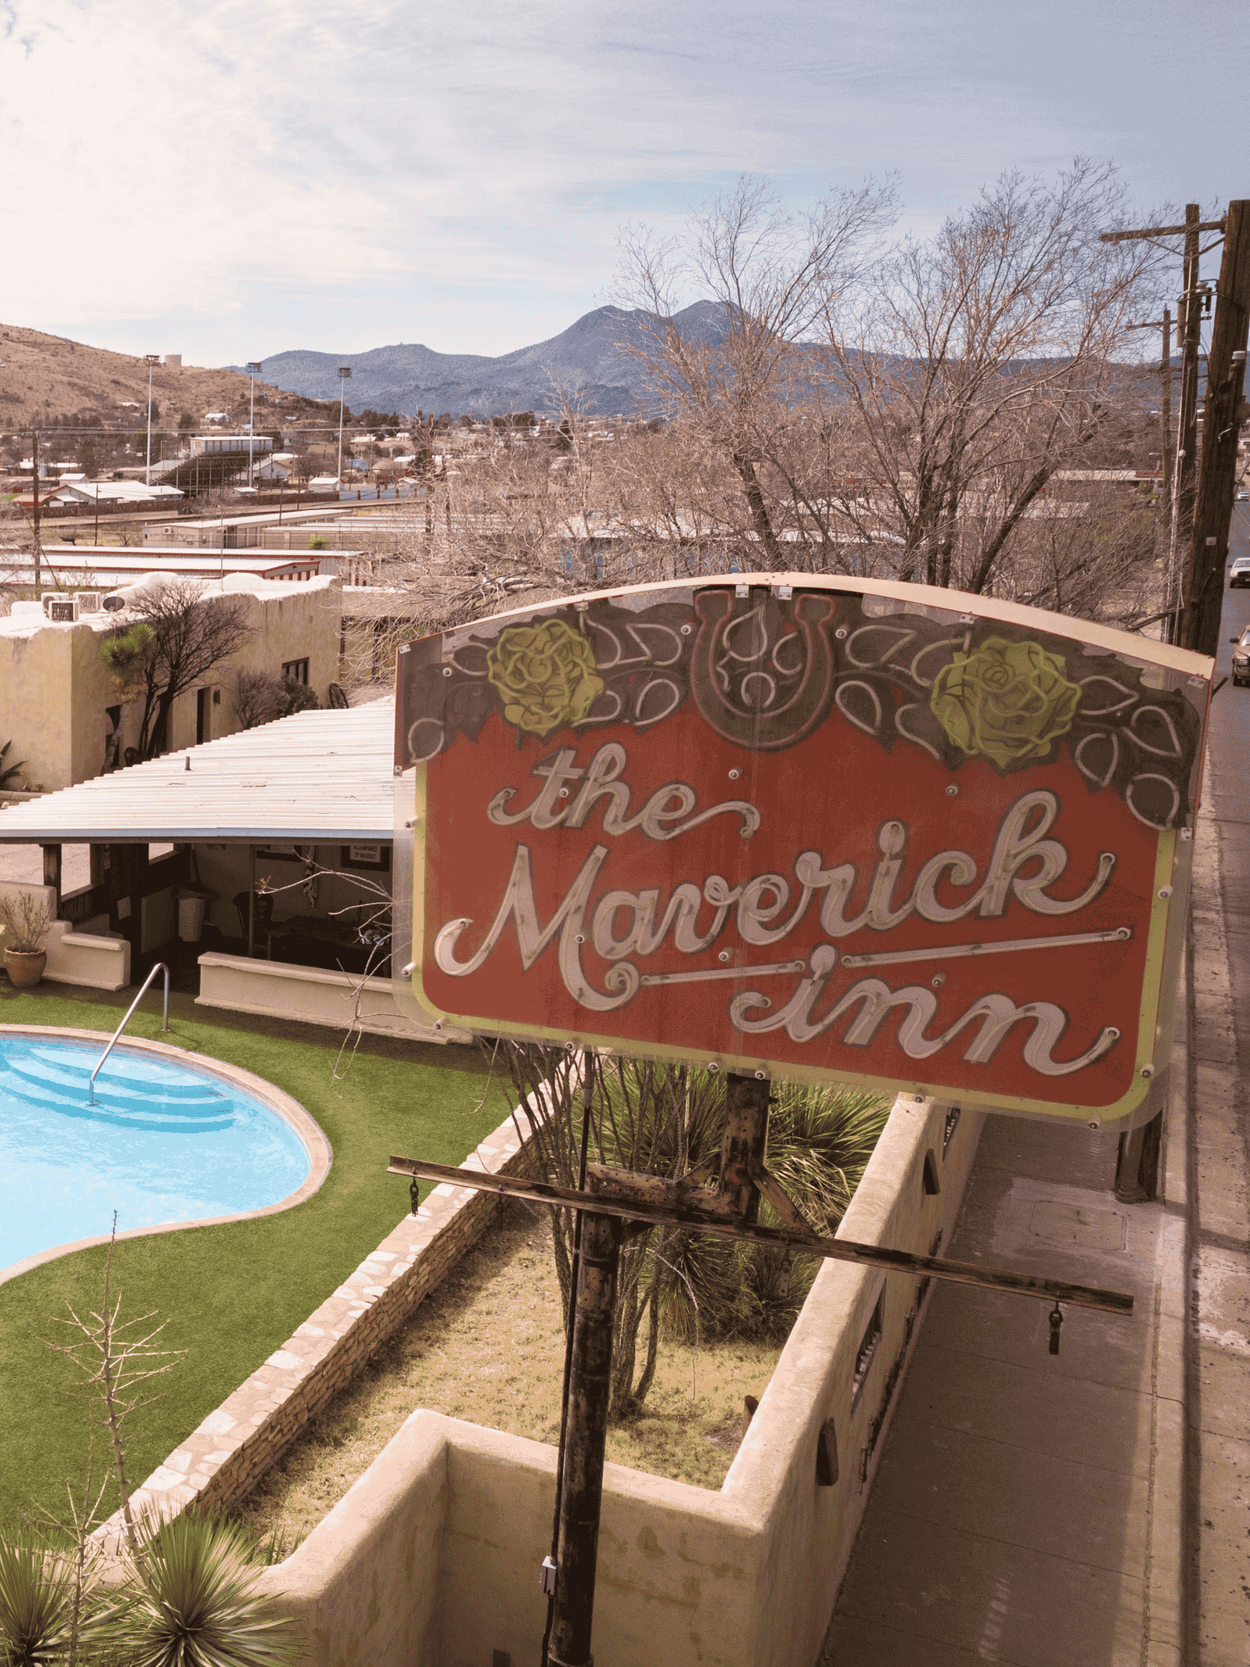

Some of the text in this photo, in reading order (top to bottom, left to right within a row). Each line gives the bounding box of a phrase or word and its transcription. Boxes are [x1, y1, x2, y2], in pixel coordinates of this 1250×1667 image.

[486, 743, 760, 840] the
[435, 790, 1117, 1011] Maverick
[729, 945, 1121, 1074] inn
